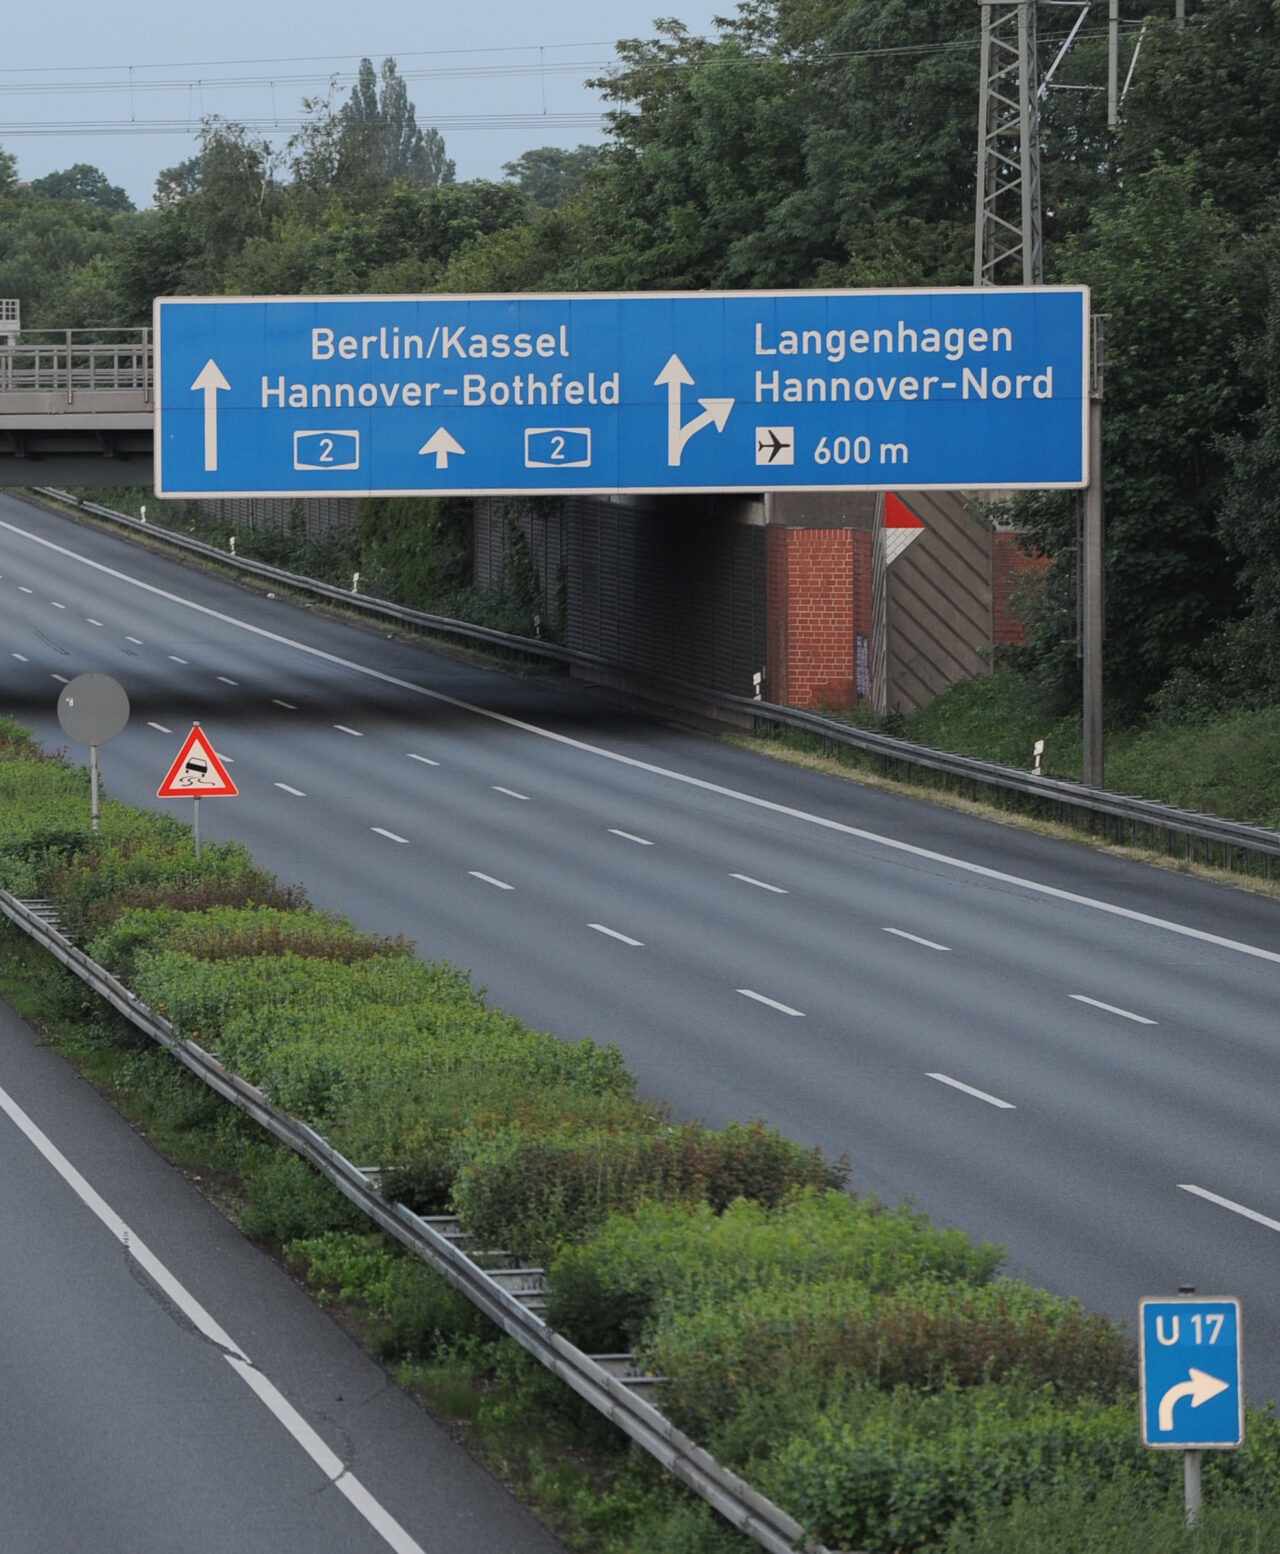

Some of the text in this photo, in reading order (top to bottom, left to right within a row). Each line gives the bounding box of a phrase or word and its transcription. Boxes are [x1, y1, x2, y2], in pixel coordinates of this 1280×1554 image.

[311, 324, 570, 360] Berlin/Kassel
[755, 320, 1014, 363] Langenhagen
[261, 372, 620, 408] Hannover-Bothfeld
[755, 366, 1054, 403] Hannover-Nord
[318, 438, 335, 462] 2
[549, 436, 566, 460] 2
[813, 435, 909, 465] 600 m
[1156, 1313, 1225, 1346] U 17
